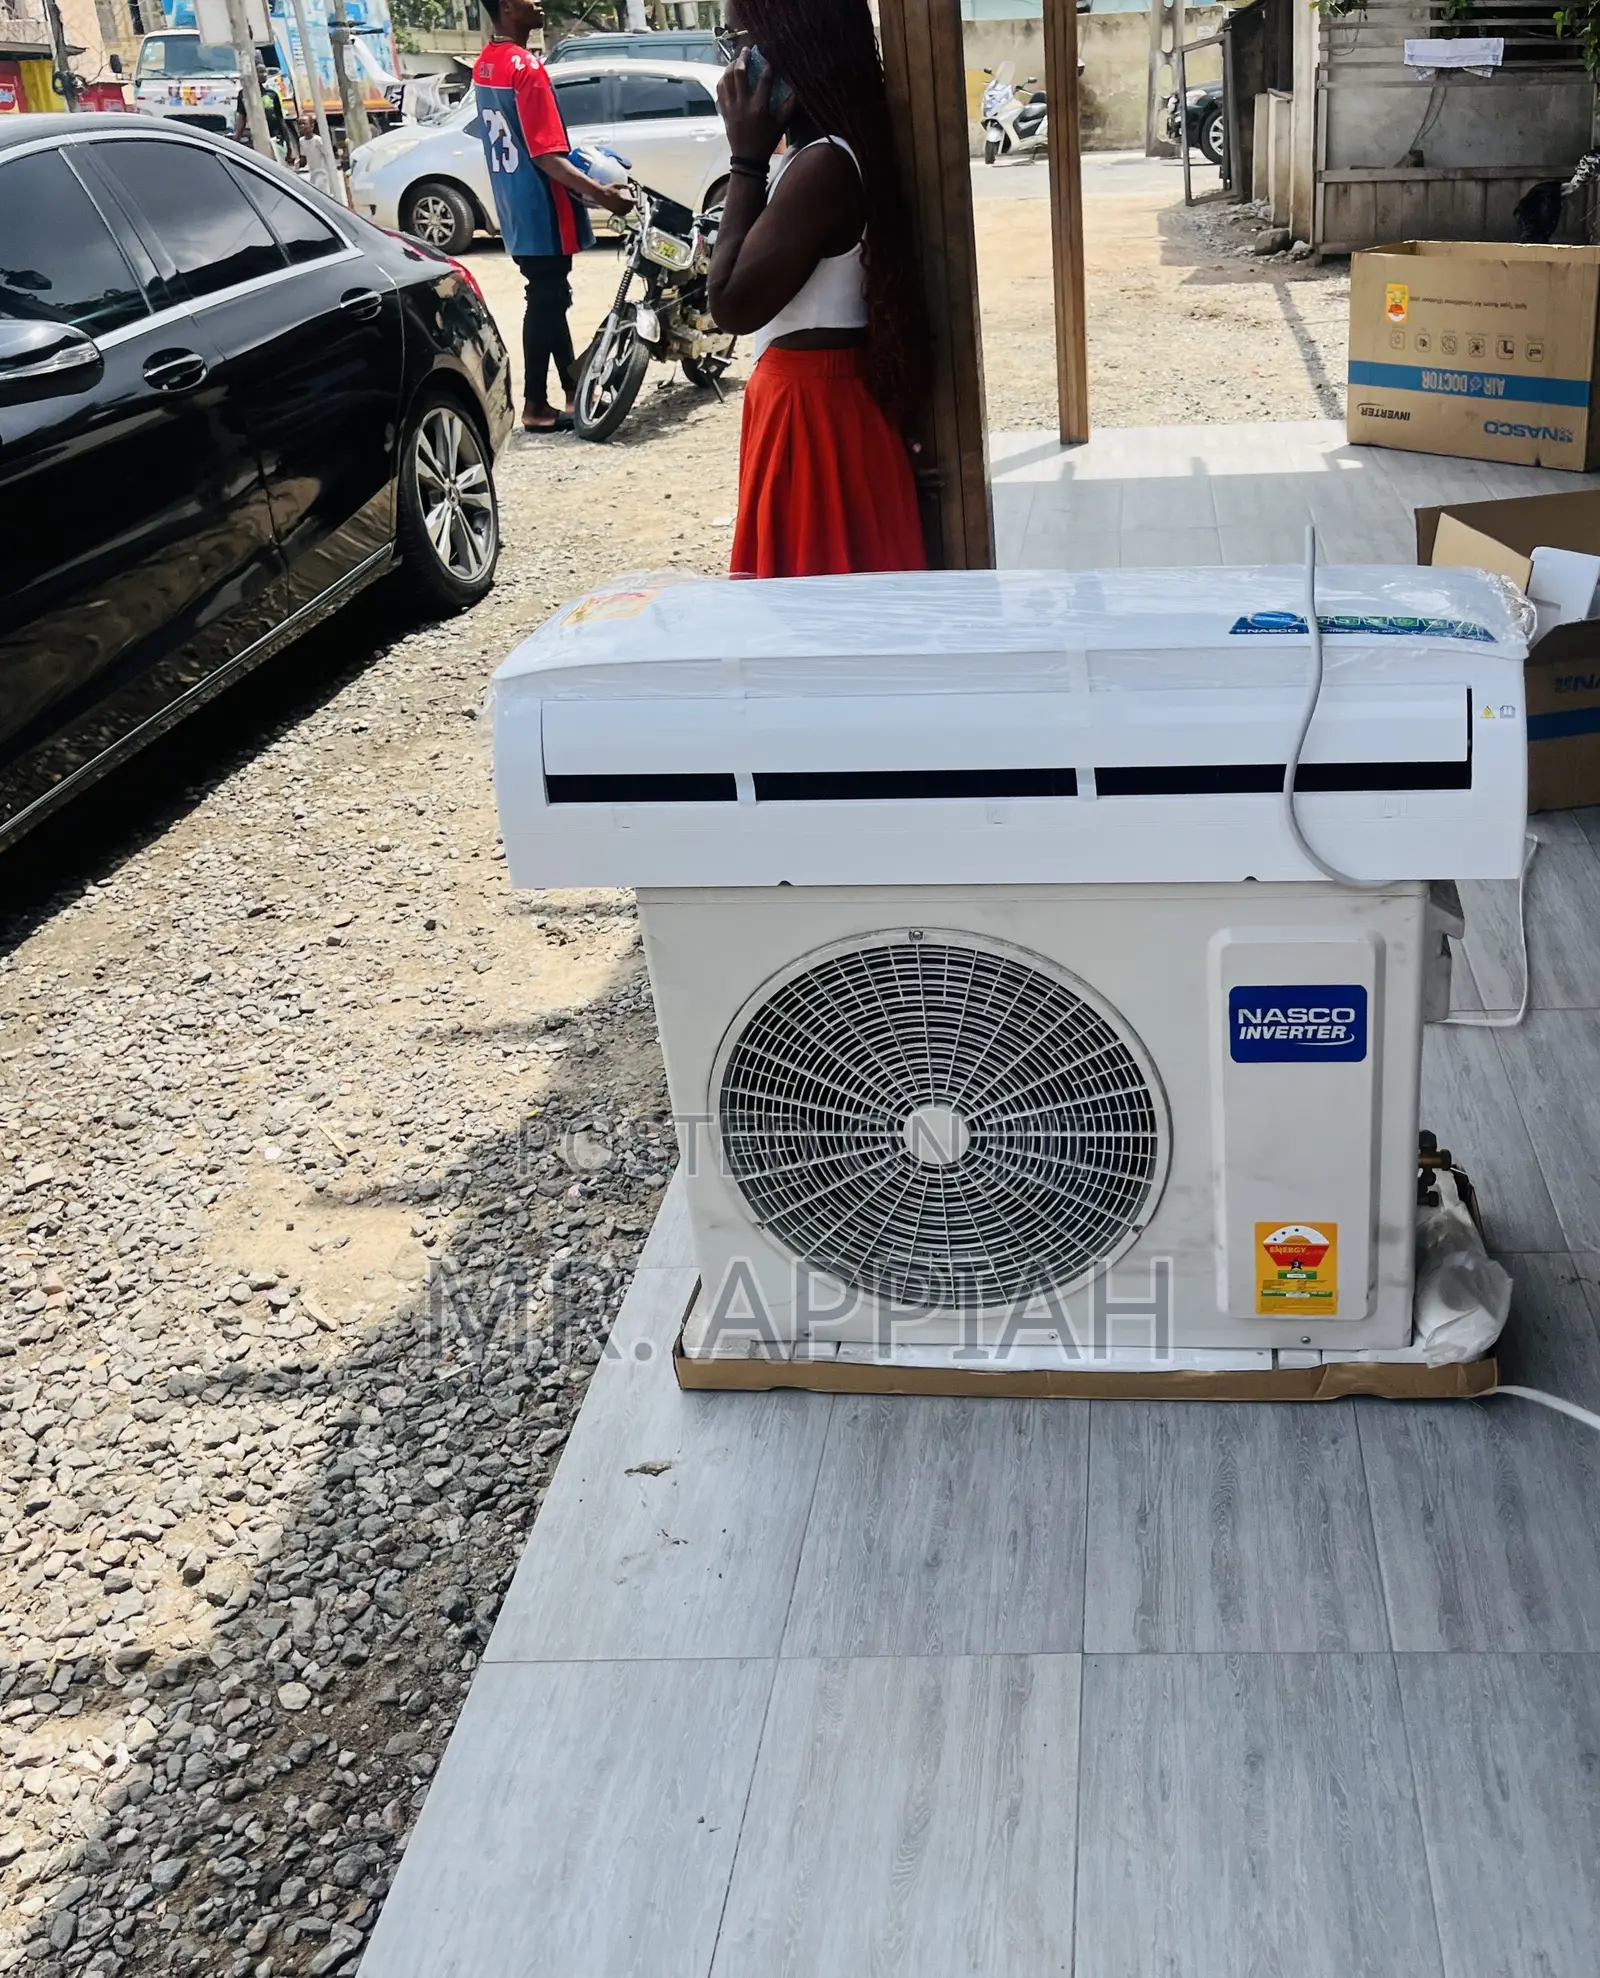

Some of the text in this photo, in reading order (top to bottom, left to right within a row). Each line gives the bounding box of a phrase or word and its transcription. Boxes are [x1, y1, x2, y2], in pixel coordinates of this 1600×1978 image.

[511, 54, 540, 72] 23
[482, 109, 519, 173] 23
[1421, 370, 1506, 396] AIR DOCTOR
[1361, 406, 1411, 421] INVERTER
[1483, 420, 1561, 442] NASCO
[1237, 1007, 1356, 1024] NASCO
[1239, 1025, 1347, 1040] INVERTER
[1270, 1246, 1307, 1254] ENERGY
